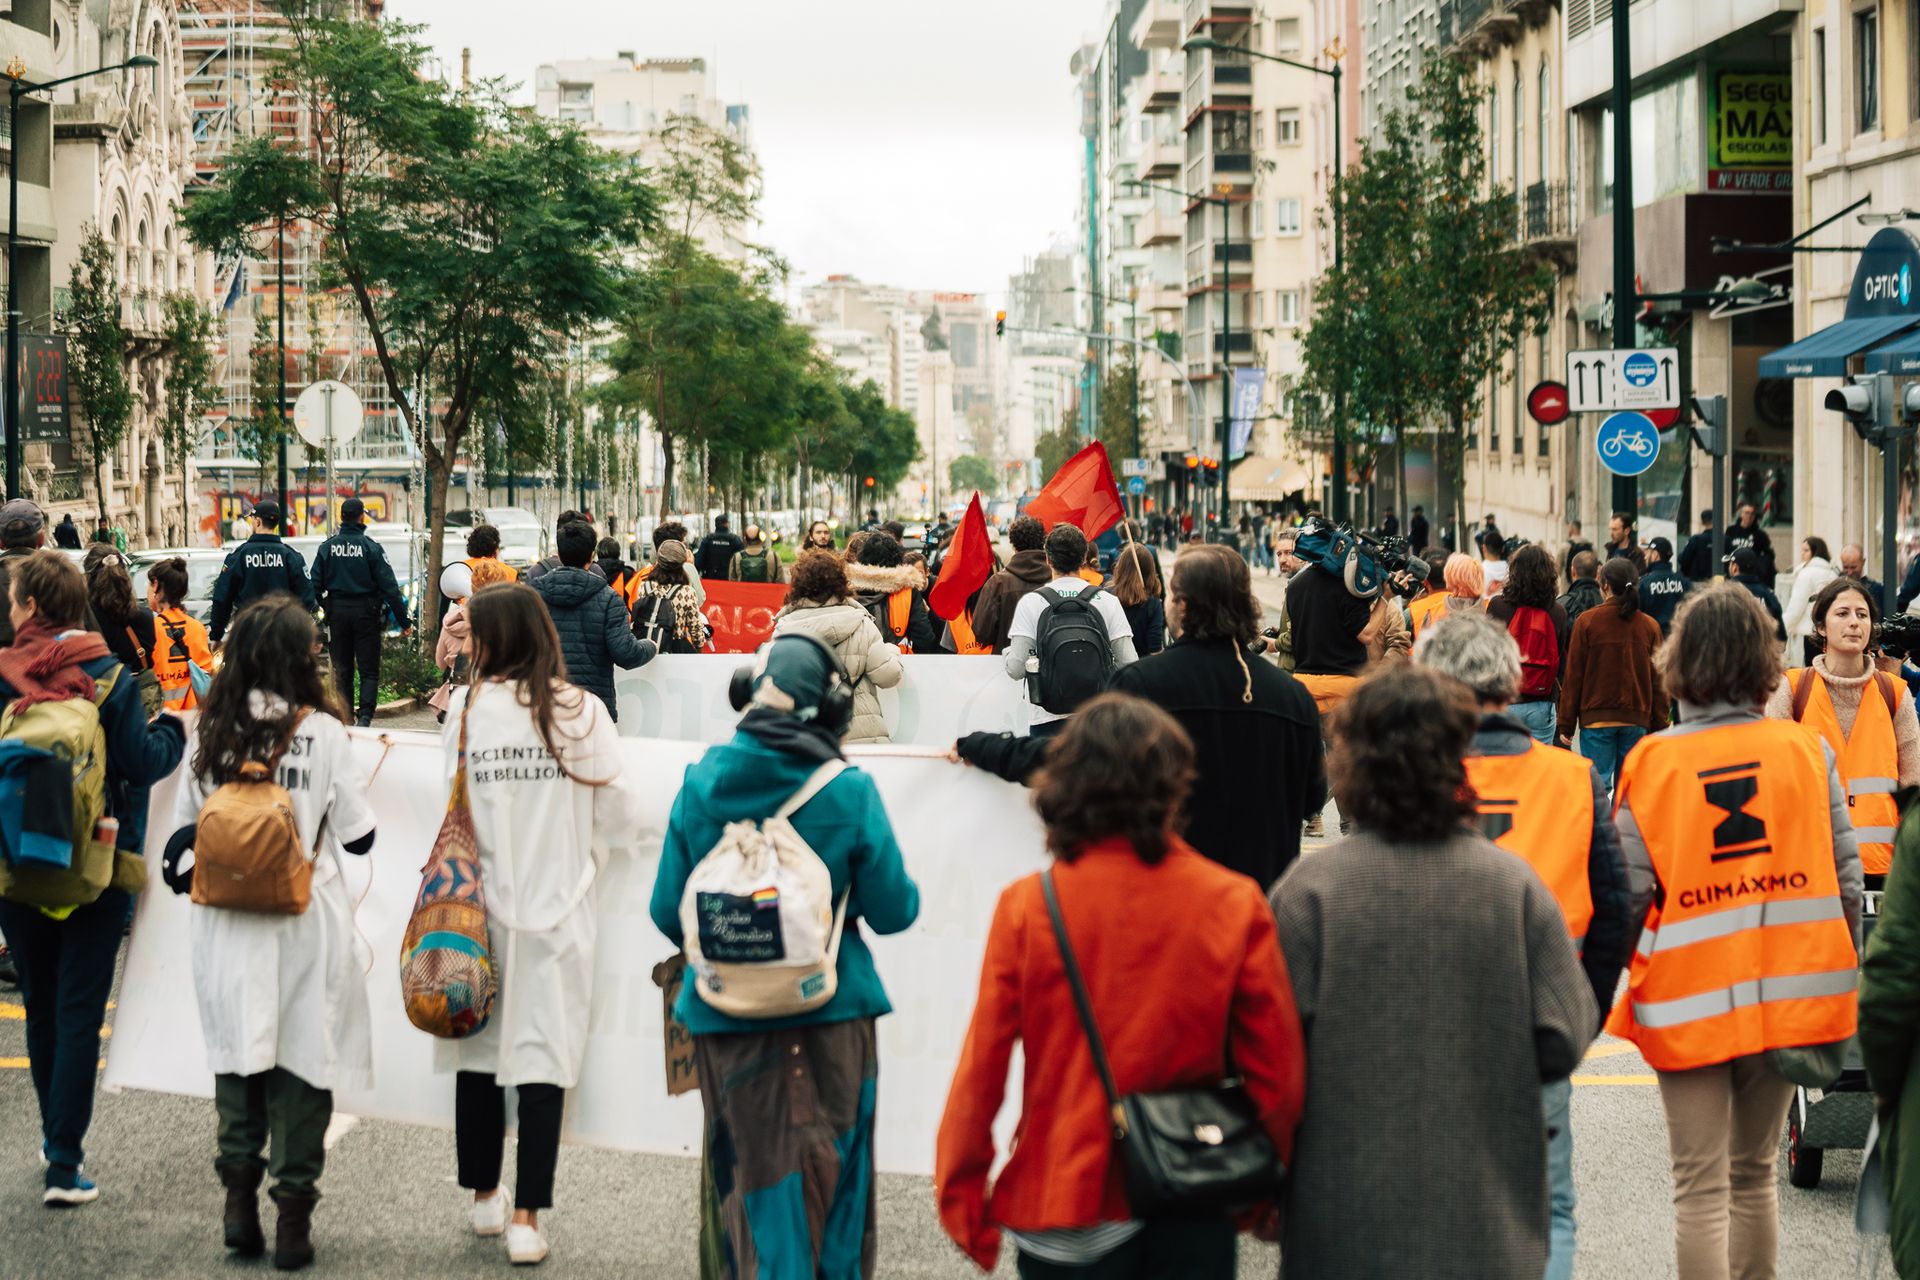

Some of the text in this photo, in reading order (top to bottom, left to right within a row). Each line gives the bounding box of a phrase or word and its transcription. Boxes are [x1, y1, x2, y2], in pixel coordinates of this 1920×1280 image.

[1727, 142, 1788, 154] ESCOLAS
[1735, 172, 1770, 188] VERDE
[331, 542, 363, 558] POLÍCIA
[245, 550, 284, 568] POLÍCIA
[1650, 578, 1684, 595] POLÍCIA
[471, 746, 567, 765] SCIENTIST
[475, 767, 567, 785] REBELLION
[1679, 872, 1808, 909] CLIMÁXMO
